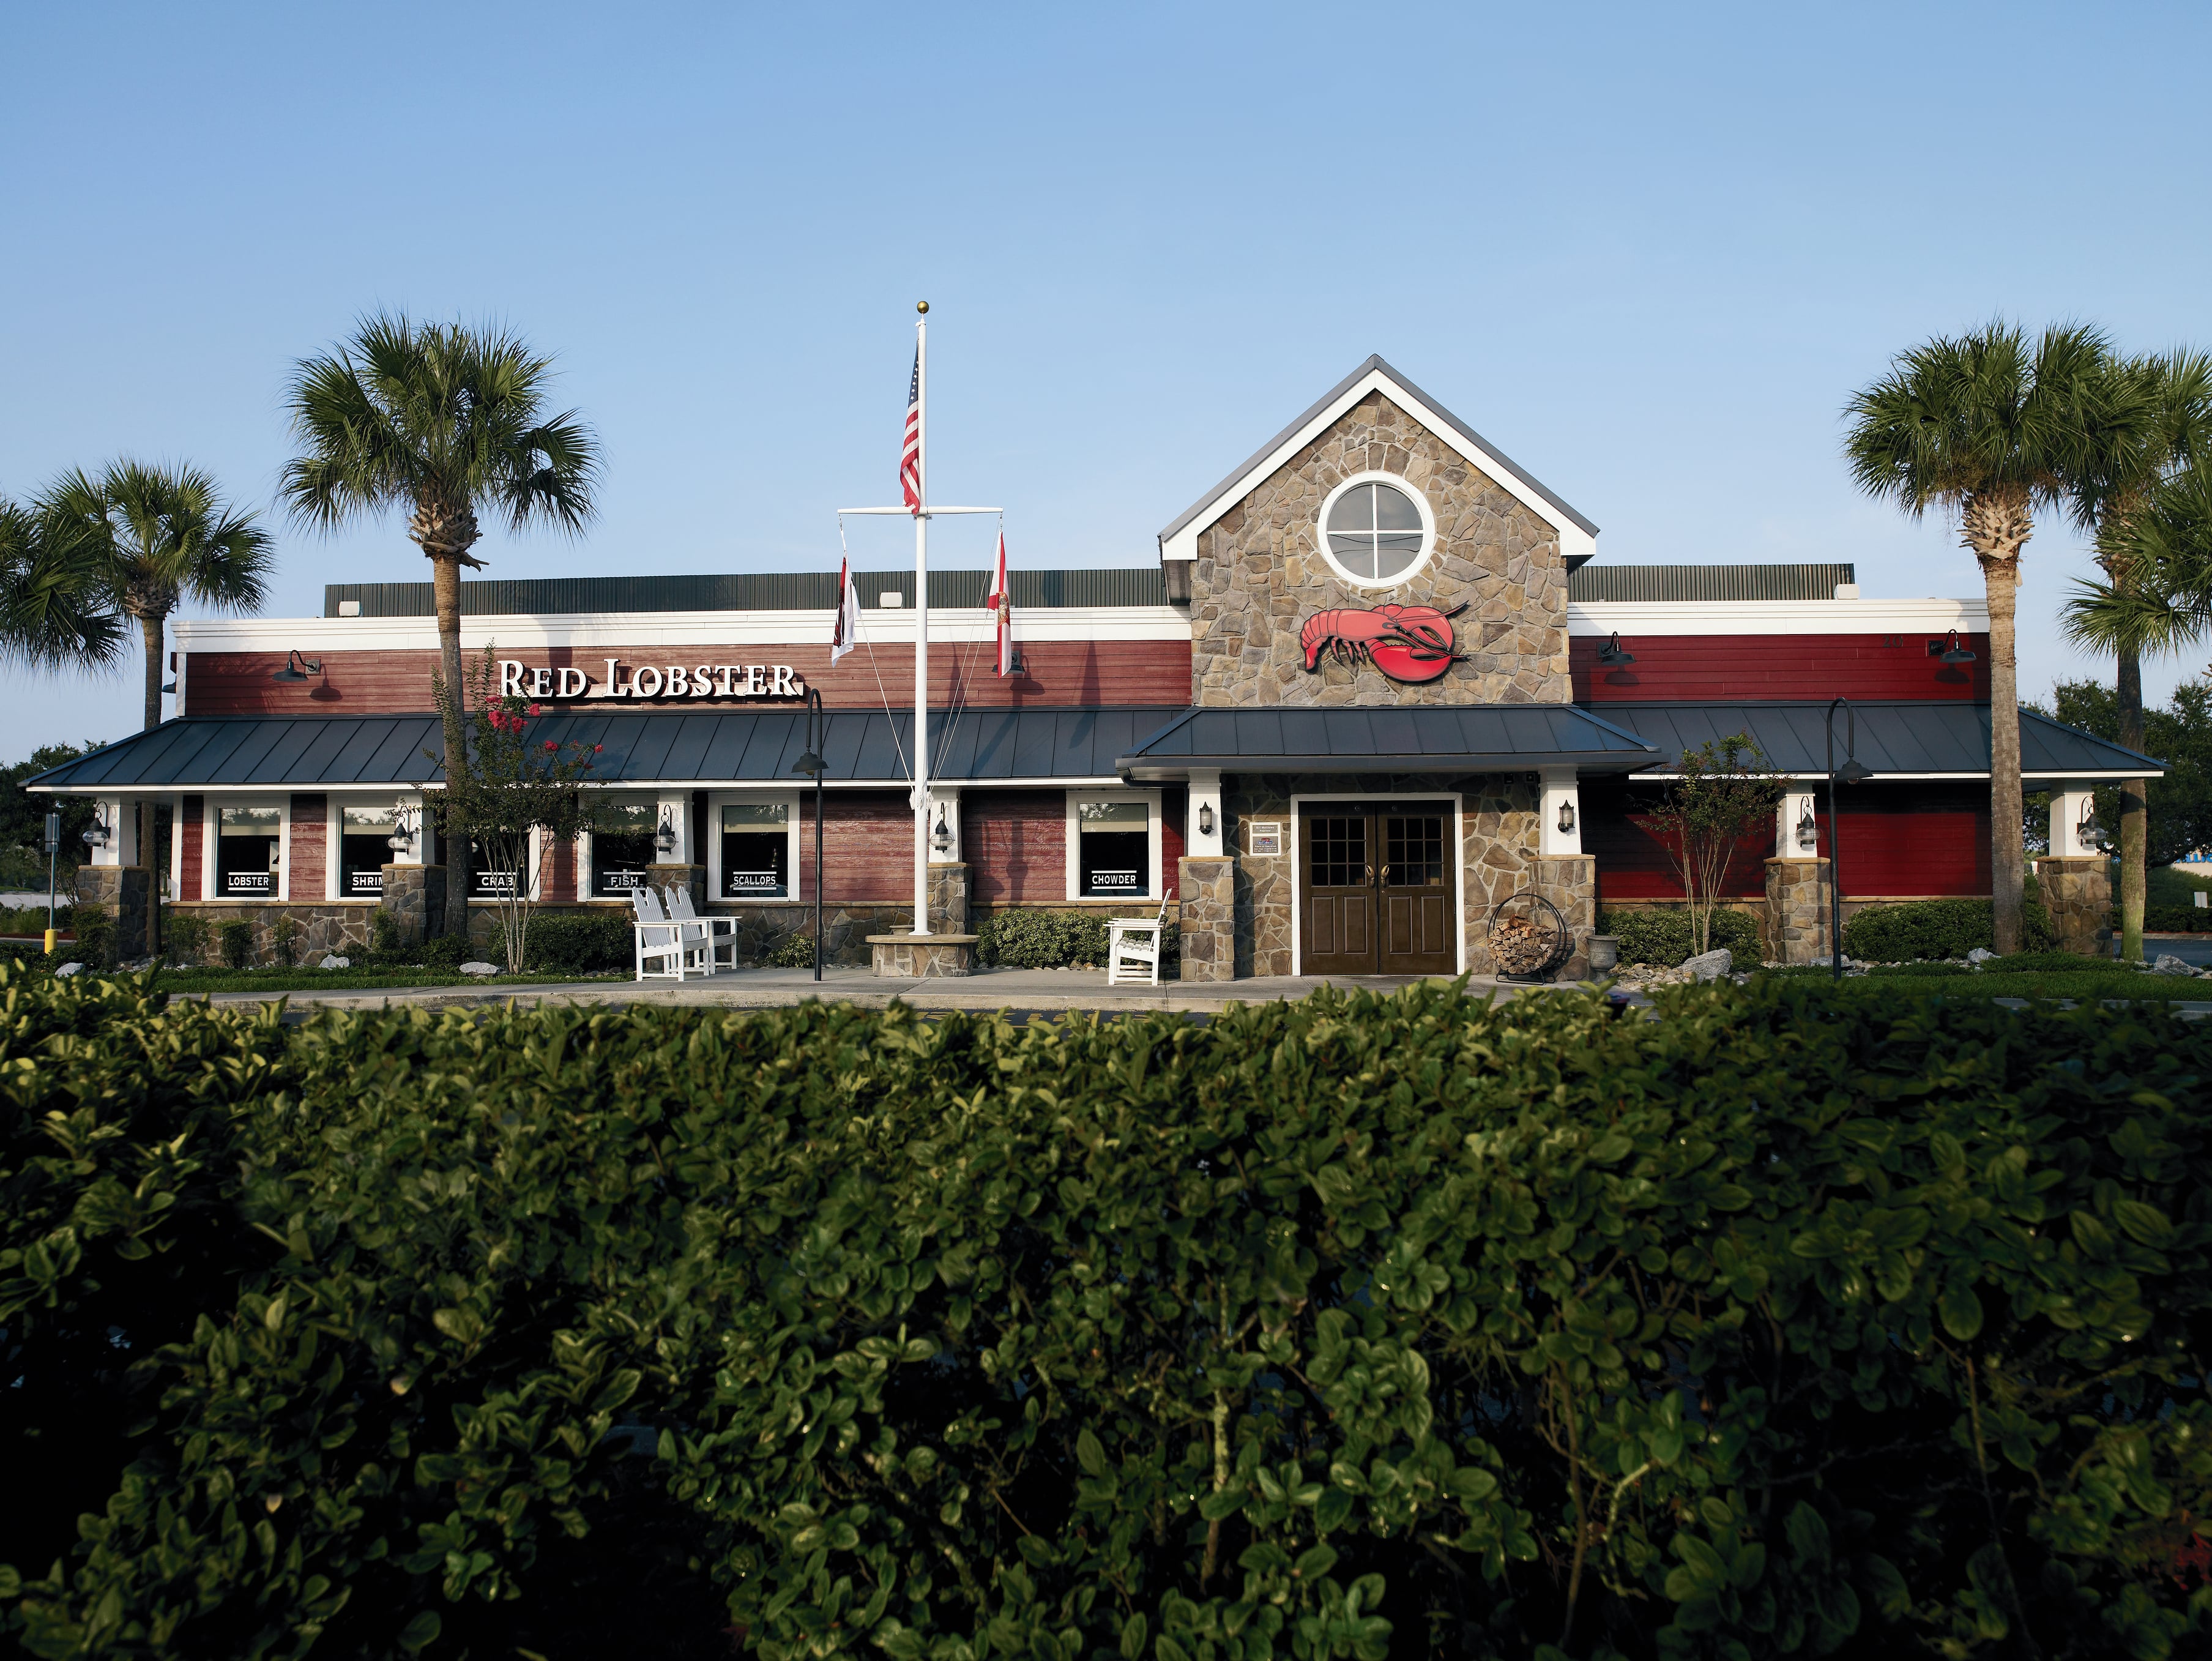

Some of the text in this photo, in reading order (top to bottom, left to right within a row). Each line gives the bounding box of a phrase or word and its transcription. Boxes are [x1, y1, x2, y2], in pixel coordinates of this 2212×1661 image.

[1882, 635, 1903, 648] 20
[497, 658, 803, 698] RED LOBSTER
[228, 876, 269, 886] LOBSTER
[611, 876, 638, 886] FISH
[734, 876, 776, 886] SCALLOPS
[1092, 875, 1136, 884] CHOWDER
